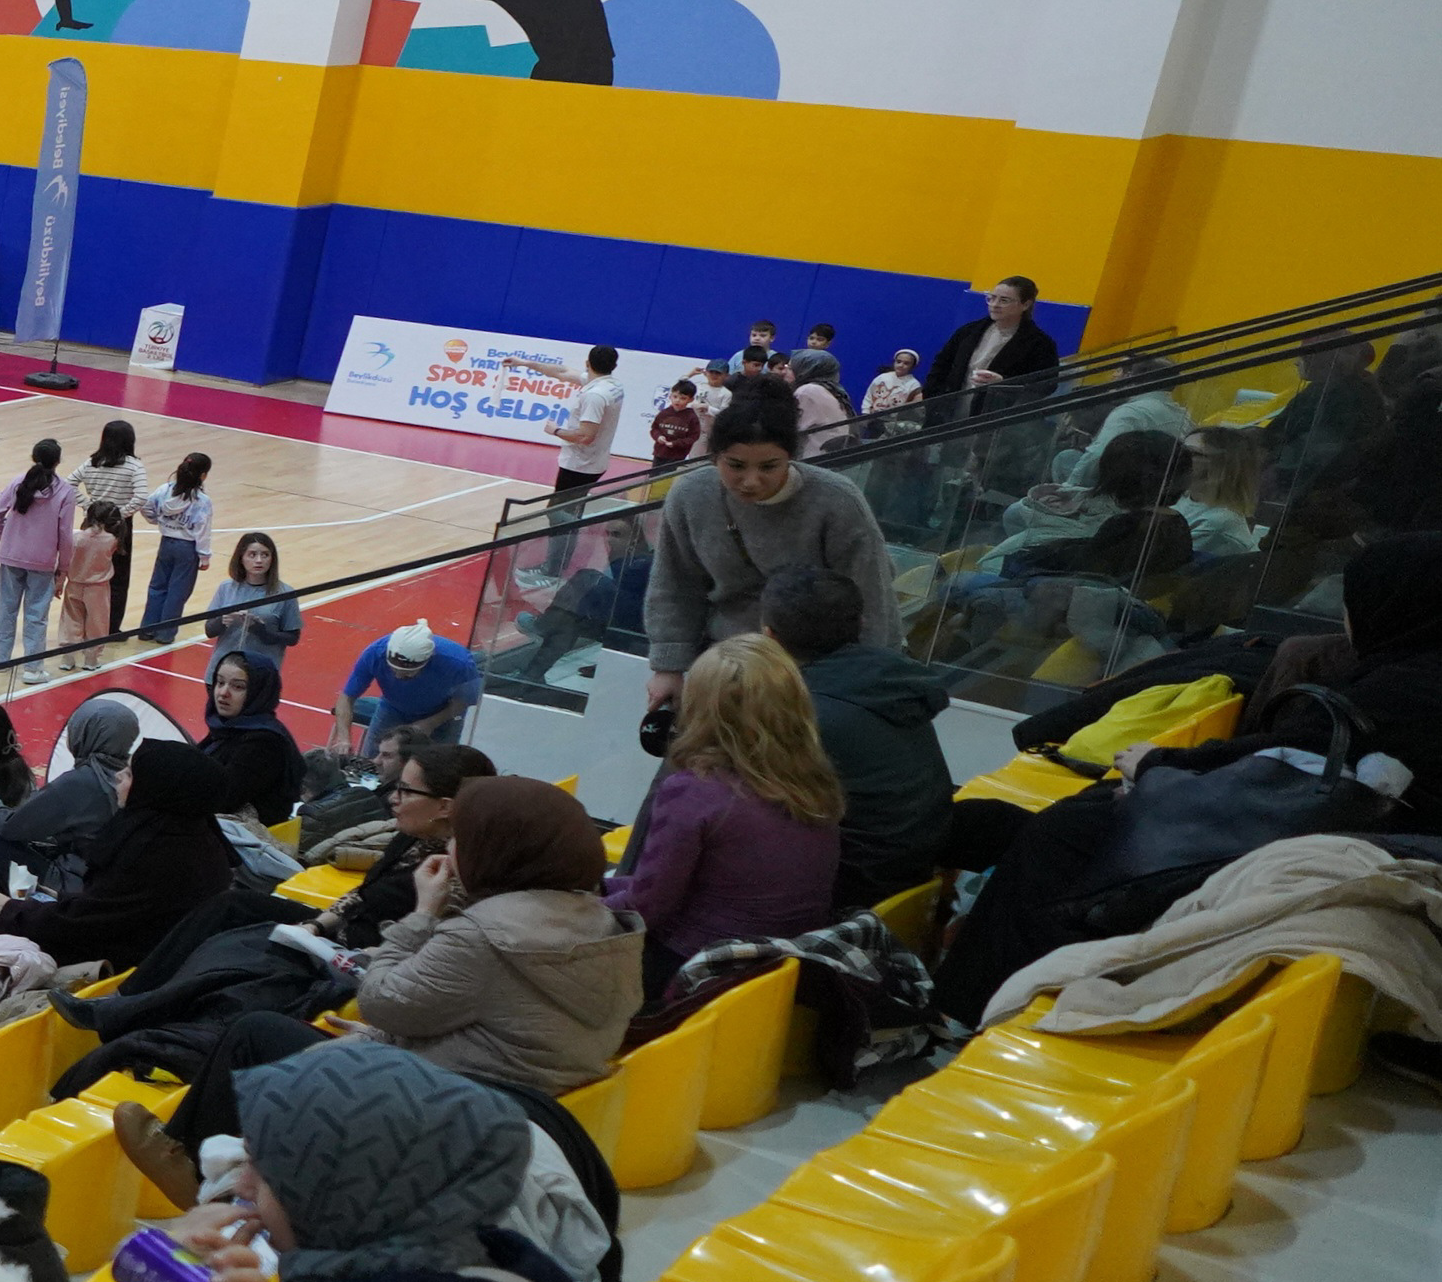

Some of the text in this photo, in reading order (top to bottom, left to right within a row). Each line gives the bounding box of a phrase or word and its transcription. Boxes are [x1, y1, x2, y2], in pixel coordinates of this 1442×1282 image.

[470, 356, 521, 373] YARIIL
[348, 371, 392, 384] Beylikdüzü
[427, 364, 486, 387] SPOR
[408, 386, 469, 419] HOŞ
